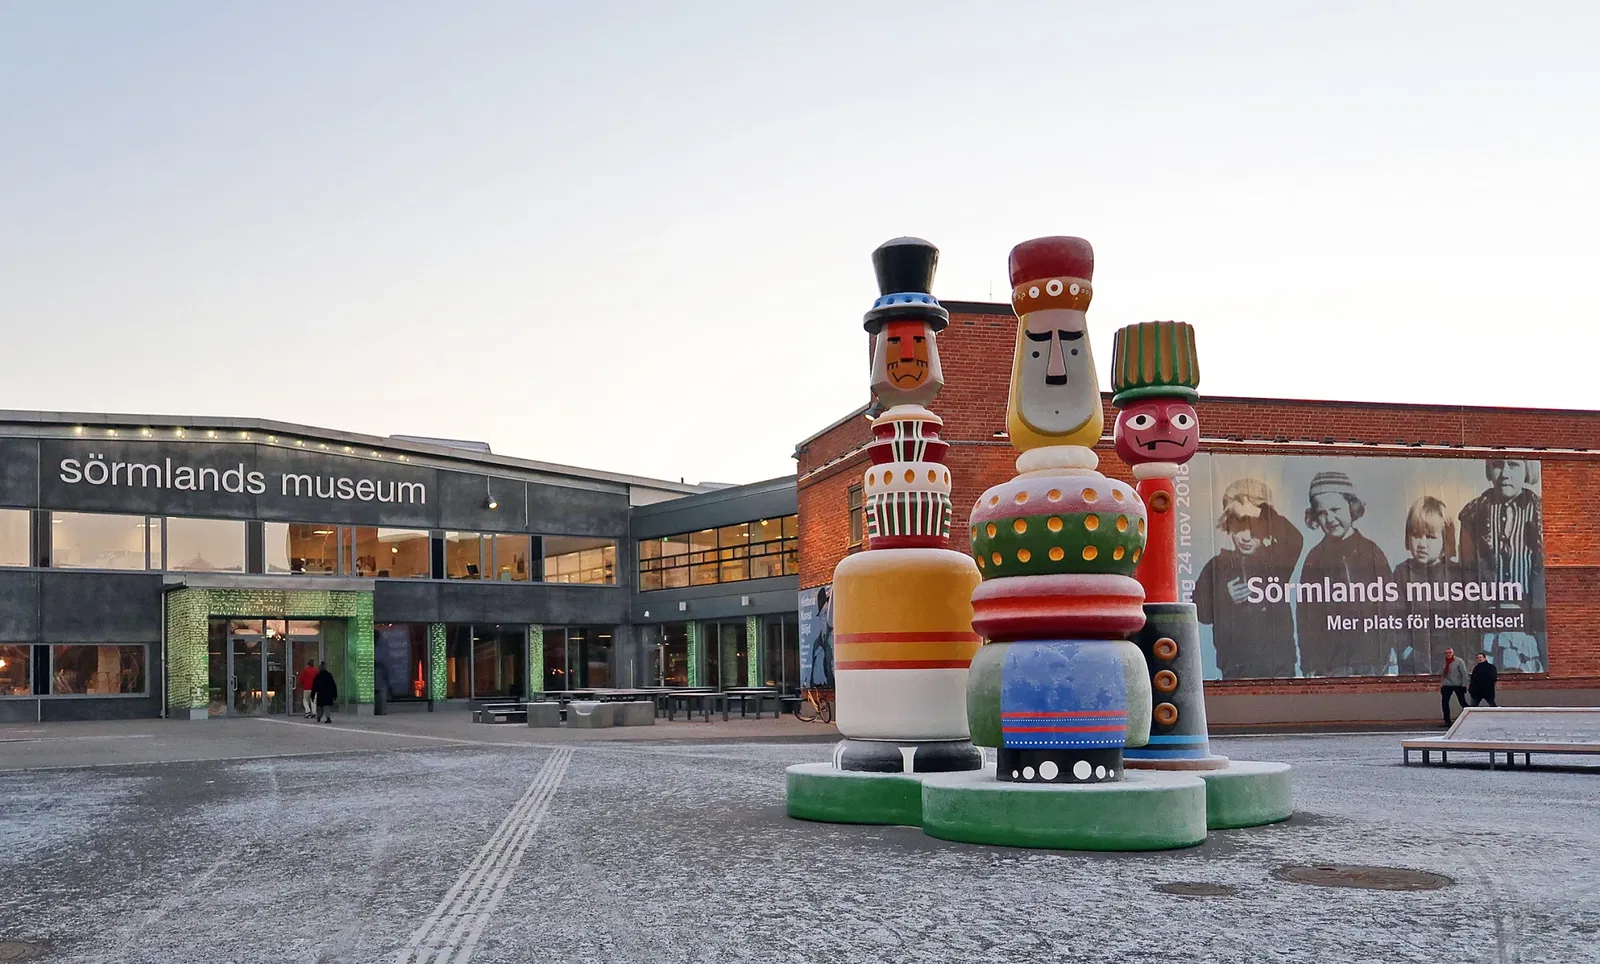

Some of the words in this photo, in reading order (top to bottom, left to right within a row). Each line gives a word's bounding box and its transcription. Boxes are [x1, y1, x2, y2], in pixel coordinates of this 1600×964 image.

[60, 453, 266, 495] sörmlands
[281, 472, 427, 504] museum
[1176, 463, 1190, 507] 2018
[1180, 512, 1191, 547] nov
[1178, 551, 1192, 575] 24
[1247, 576, 1398, 603] Sörmlands
[1406, 580, 1524, 602] museum
[1327, 614, 1359, 630] Mer
[1363, 615, 1403, 633] plats
[1406, 613, 1430, 629] för
[1434, 613, 1525, 629] berättelser!
